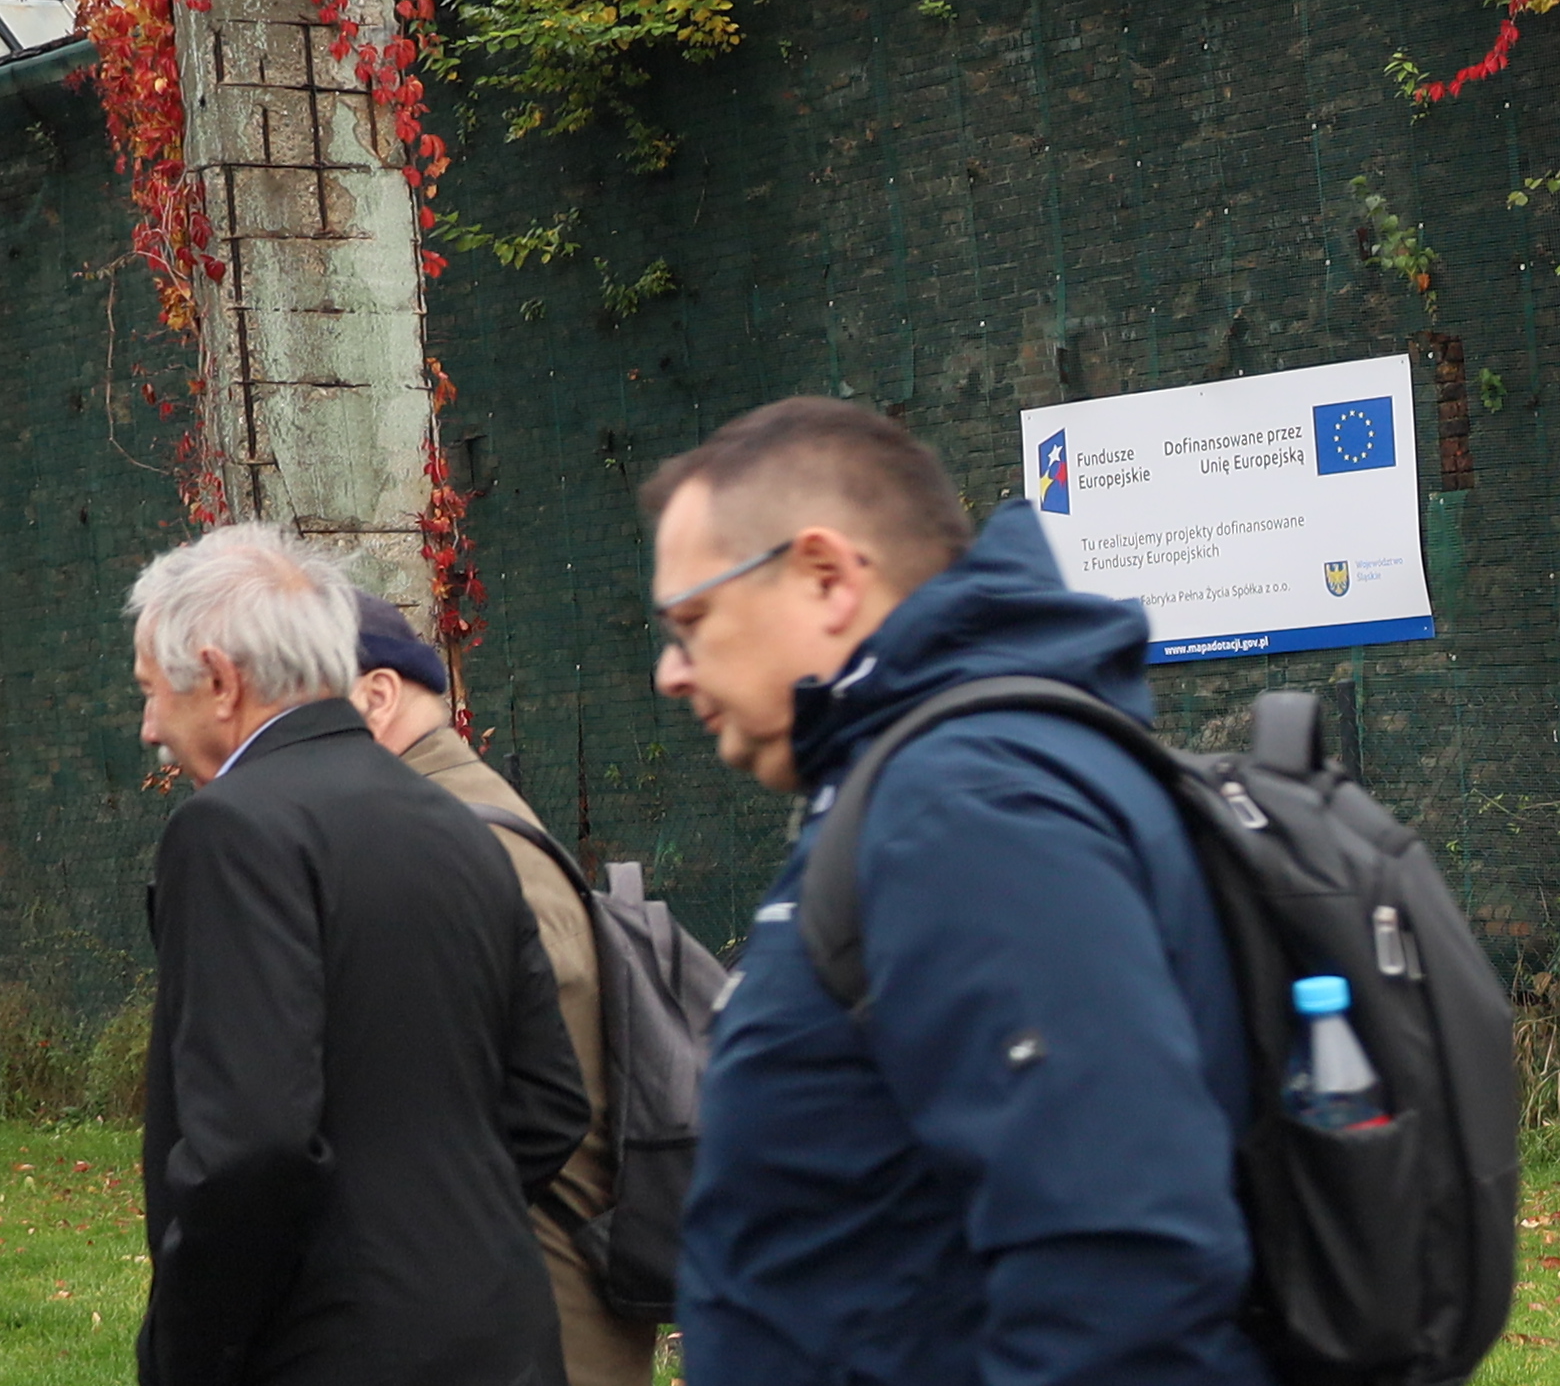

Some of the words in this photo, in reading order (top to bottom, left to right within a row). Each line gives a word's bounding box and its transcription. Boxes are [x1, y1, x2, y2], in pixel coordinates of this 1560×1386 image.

[1164, 431, 1264, 456] Dofinansowane
[1267, 426, 1302, 445] przez
[1077, 448, 1135, 468] Fundusze
[1200, 456, 1230, 475] Unię
[1234, 446, 1305, 470] Europejską
[1078, 466, 1151, 490] Europejskie
[1081, 538, 1096, 551] Tu
[1098, 531, 1162, 550] realizujemy
[1166, 524, 1214, 546] projekty
[1216, 515, 1305, 536] dofinansowane
[1083, 560, 1090, 571] z
[1092, 553, 1144, 571] Funduszy
[1147, 543, 1220, 565] Europejskich
[1140, 592, 1177, 607] Fabryka
[1179, 590, 1204, 602] Pełna
[1206, 585, 1230, 602] Życia
[1232, 583, 1263, 599] Spółka
[1265, 584, 1271, 593] z
[1163, 635, 1269, 656] www.mapadotacji.gov.pl
